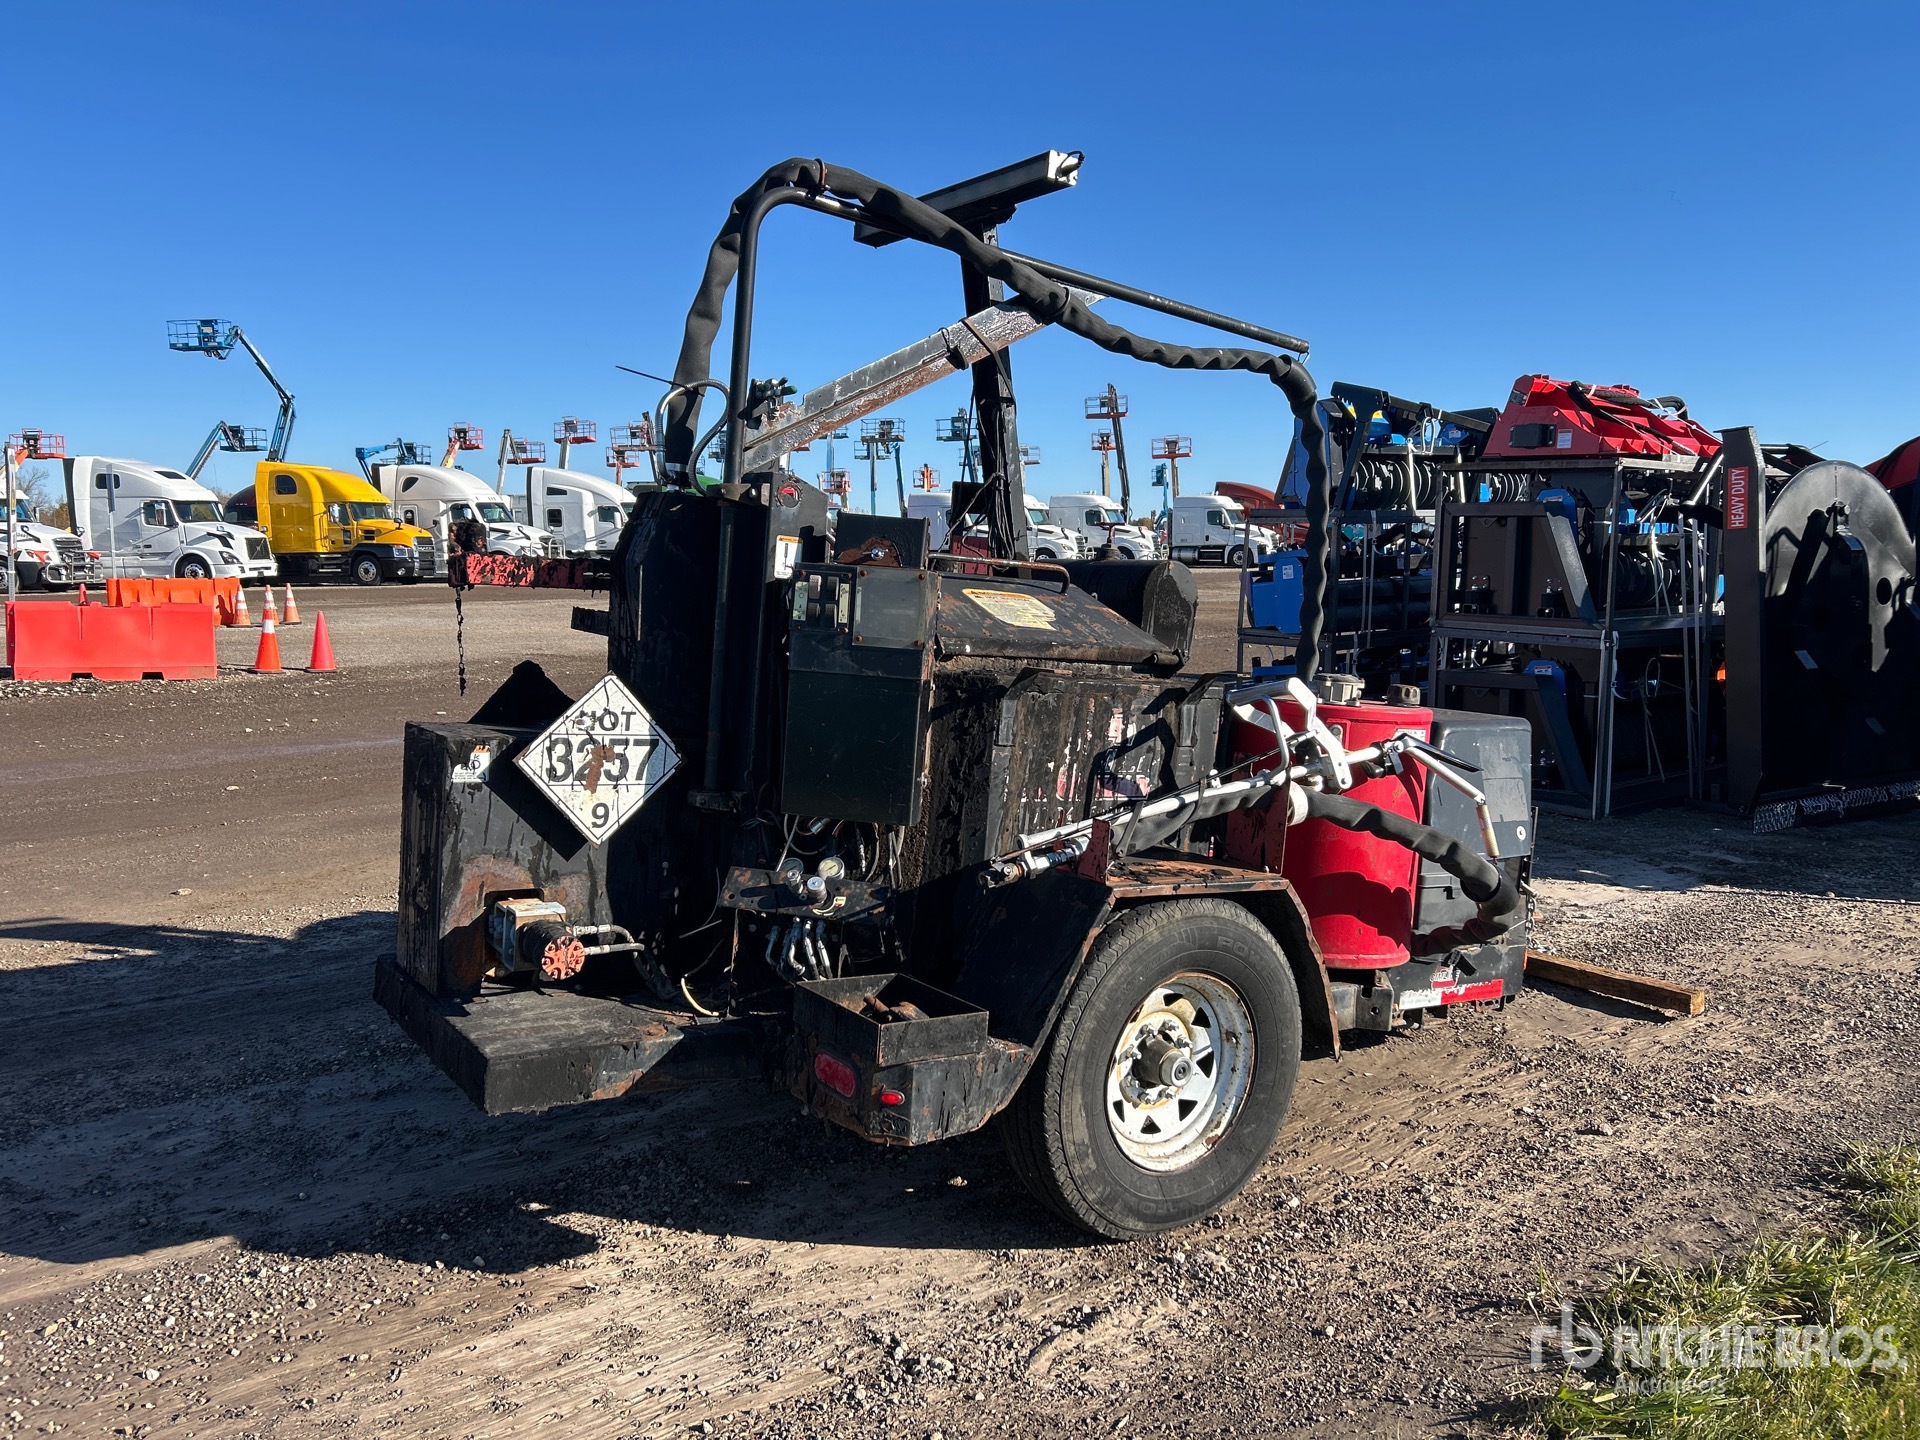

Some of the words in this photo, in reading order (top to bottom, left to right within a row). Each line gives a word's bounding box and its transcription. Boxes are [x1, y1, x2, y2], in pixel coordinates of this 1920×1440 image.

[1731, 469, 1744, 494] DUTY
[1731, 498, 1744, 527] HEAVY
[546, 738, 659, 782] 3257
[592, 803, 610, 828] 9
